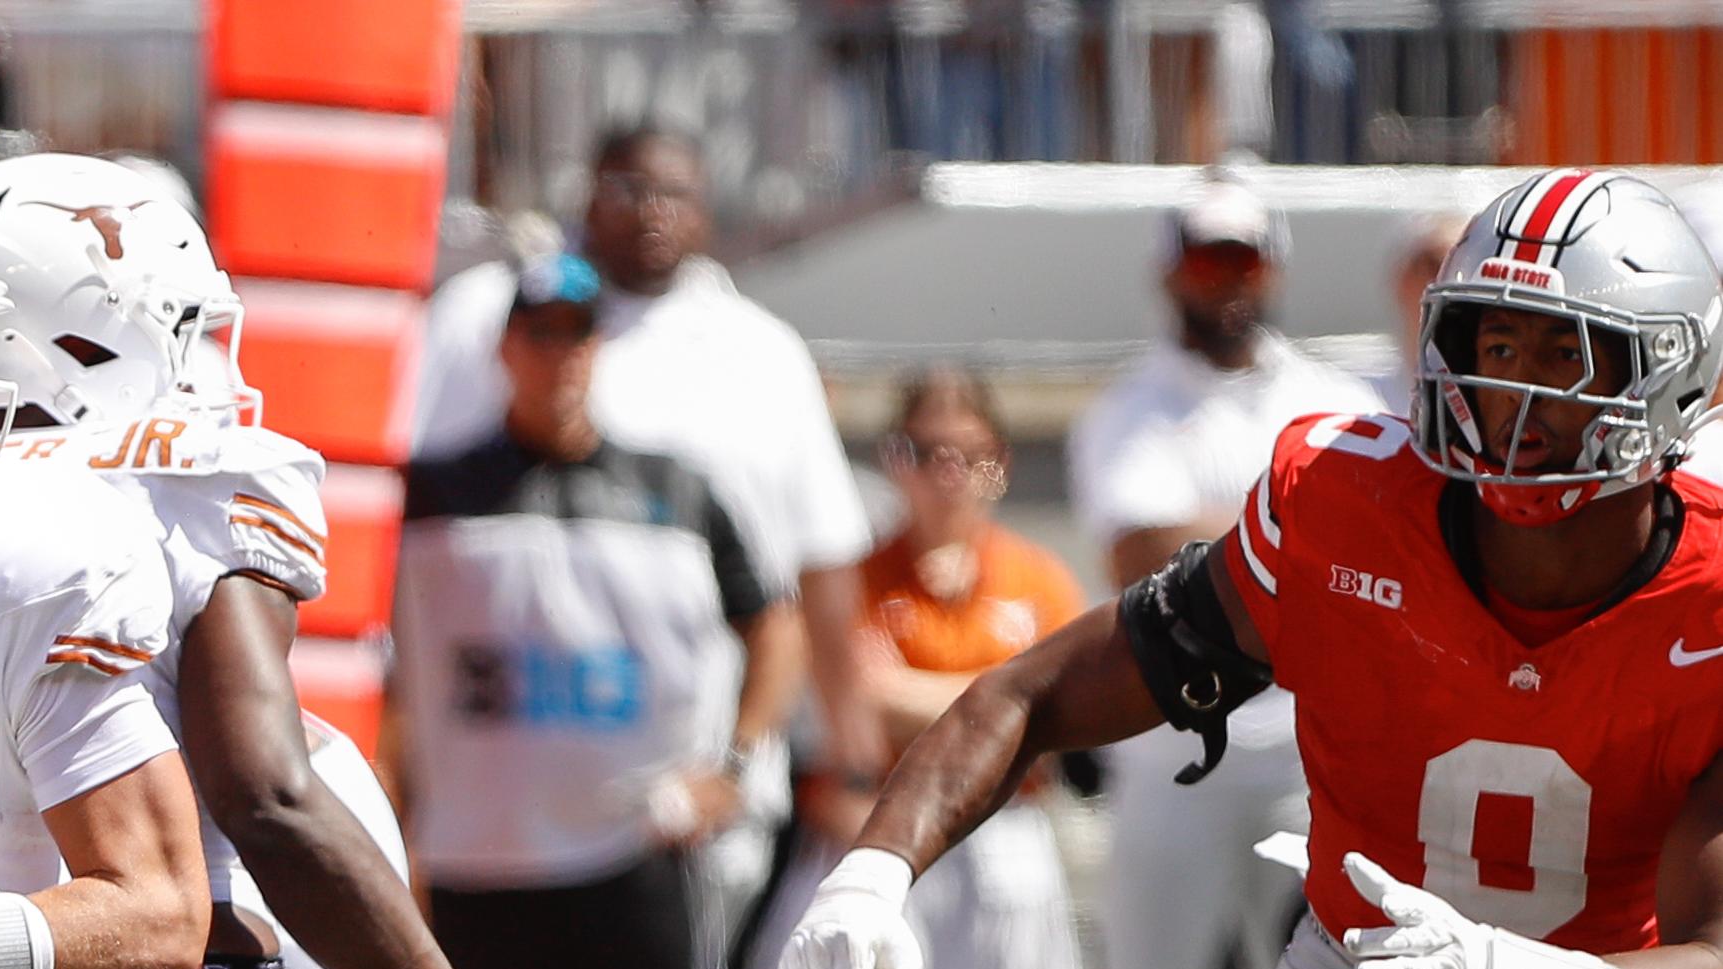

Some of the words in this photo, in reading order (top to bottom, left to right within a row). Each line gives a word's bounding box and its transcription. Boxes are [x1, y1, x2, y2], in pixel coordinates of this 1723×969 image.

[1512, 267, 1551, 289] STATE
[88, 418, 194, 469] JR.
[1417, 738, 1592, 939] 0
